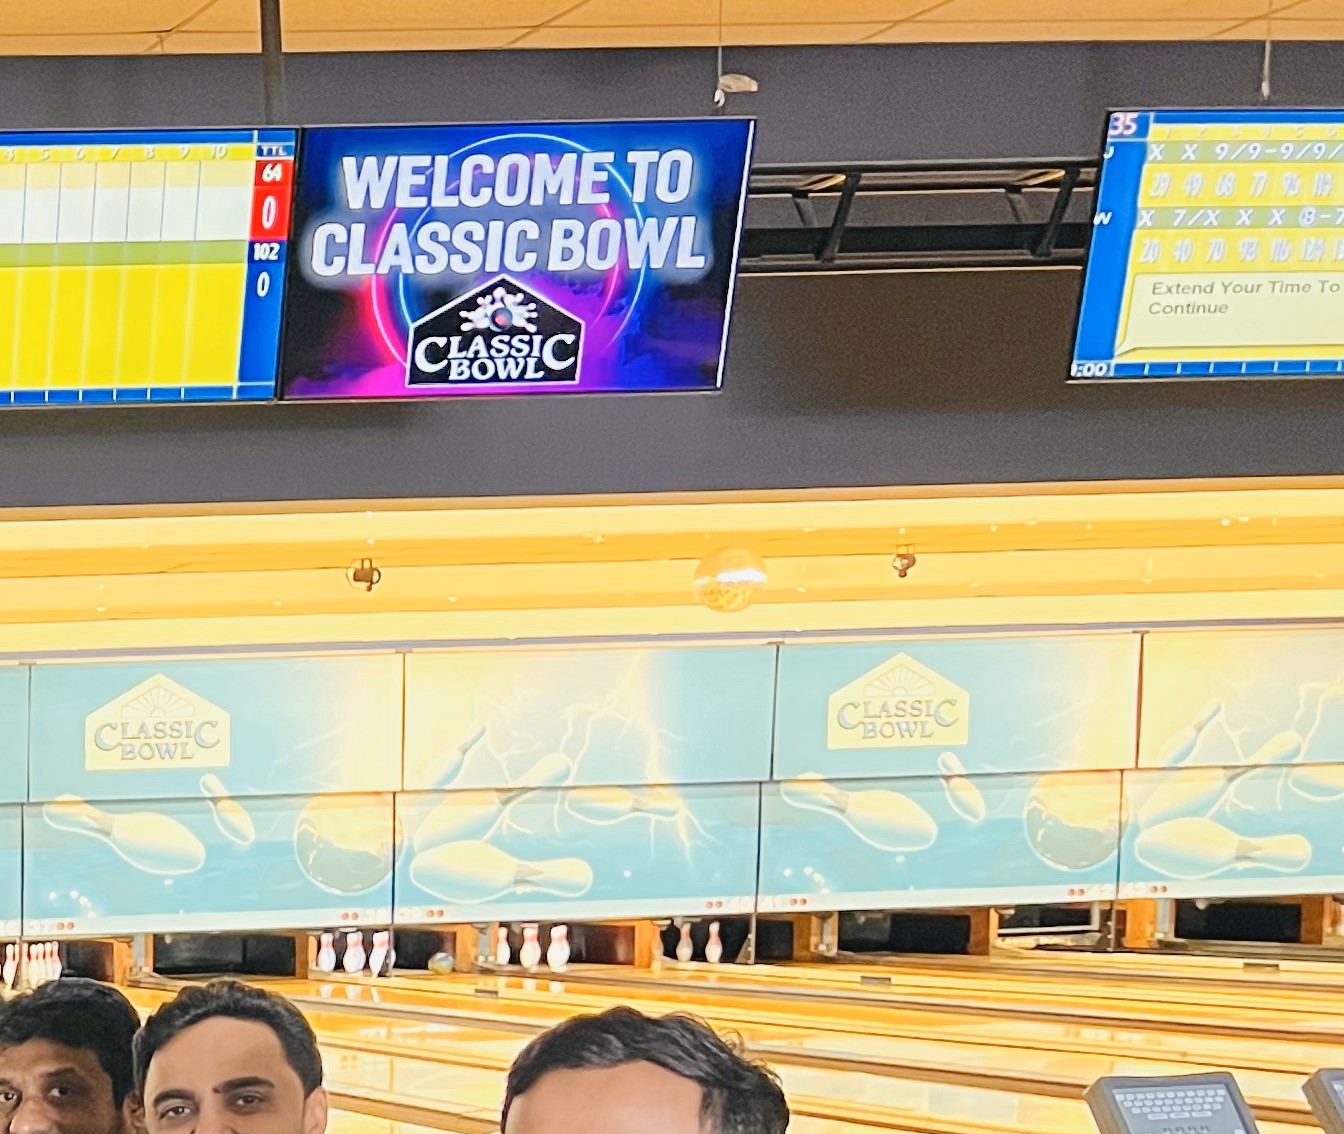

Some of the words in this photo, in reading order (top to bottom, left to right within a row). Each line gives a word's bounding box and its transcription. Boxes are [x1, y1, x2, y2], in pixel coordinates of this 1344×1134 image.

[1108, 112, 1140, 138] 35
[261, 144, 289, 158] TTL
[261, 163, 283, 183] 64
[342, 150, 612, 210] WELCOME
[625, 148, 694, 205] TO
[261, 195, 277, 229] 0
[253, 242, 281, 261] 102
[310, 219, 544, 279] CLASSIC
[547, 214, 708, 273] BOWL
[256, 271, 270, 297] 0
[1152, 280, 1214, 296] Extend
[1221, 280, 1263, 295] Your
[1269, 280, 1312, 294] Time
[1319, 279, 1341, 293] To
[1148, 302, 1229, 315] Continue
[414, 334, 576, 375] CLASSIC
[448, 355, 547, 383] BOWL
[837, 699, 959, 729] CLASSIC
[94, 720, 220, 751] CLASSIC
[862, 720, 934, 739] BOWL
[120, 741, 195, 760] BOWL
